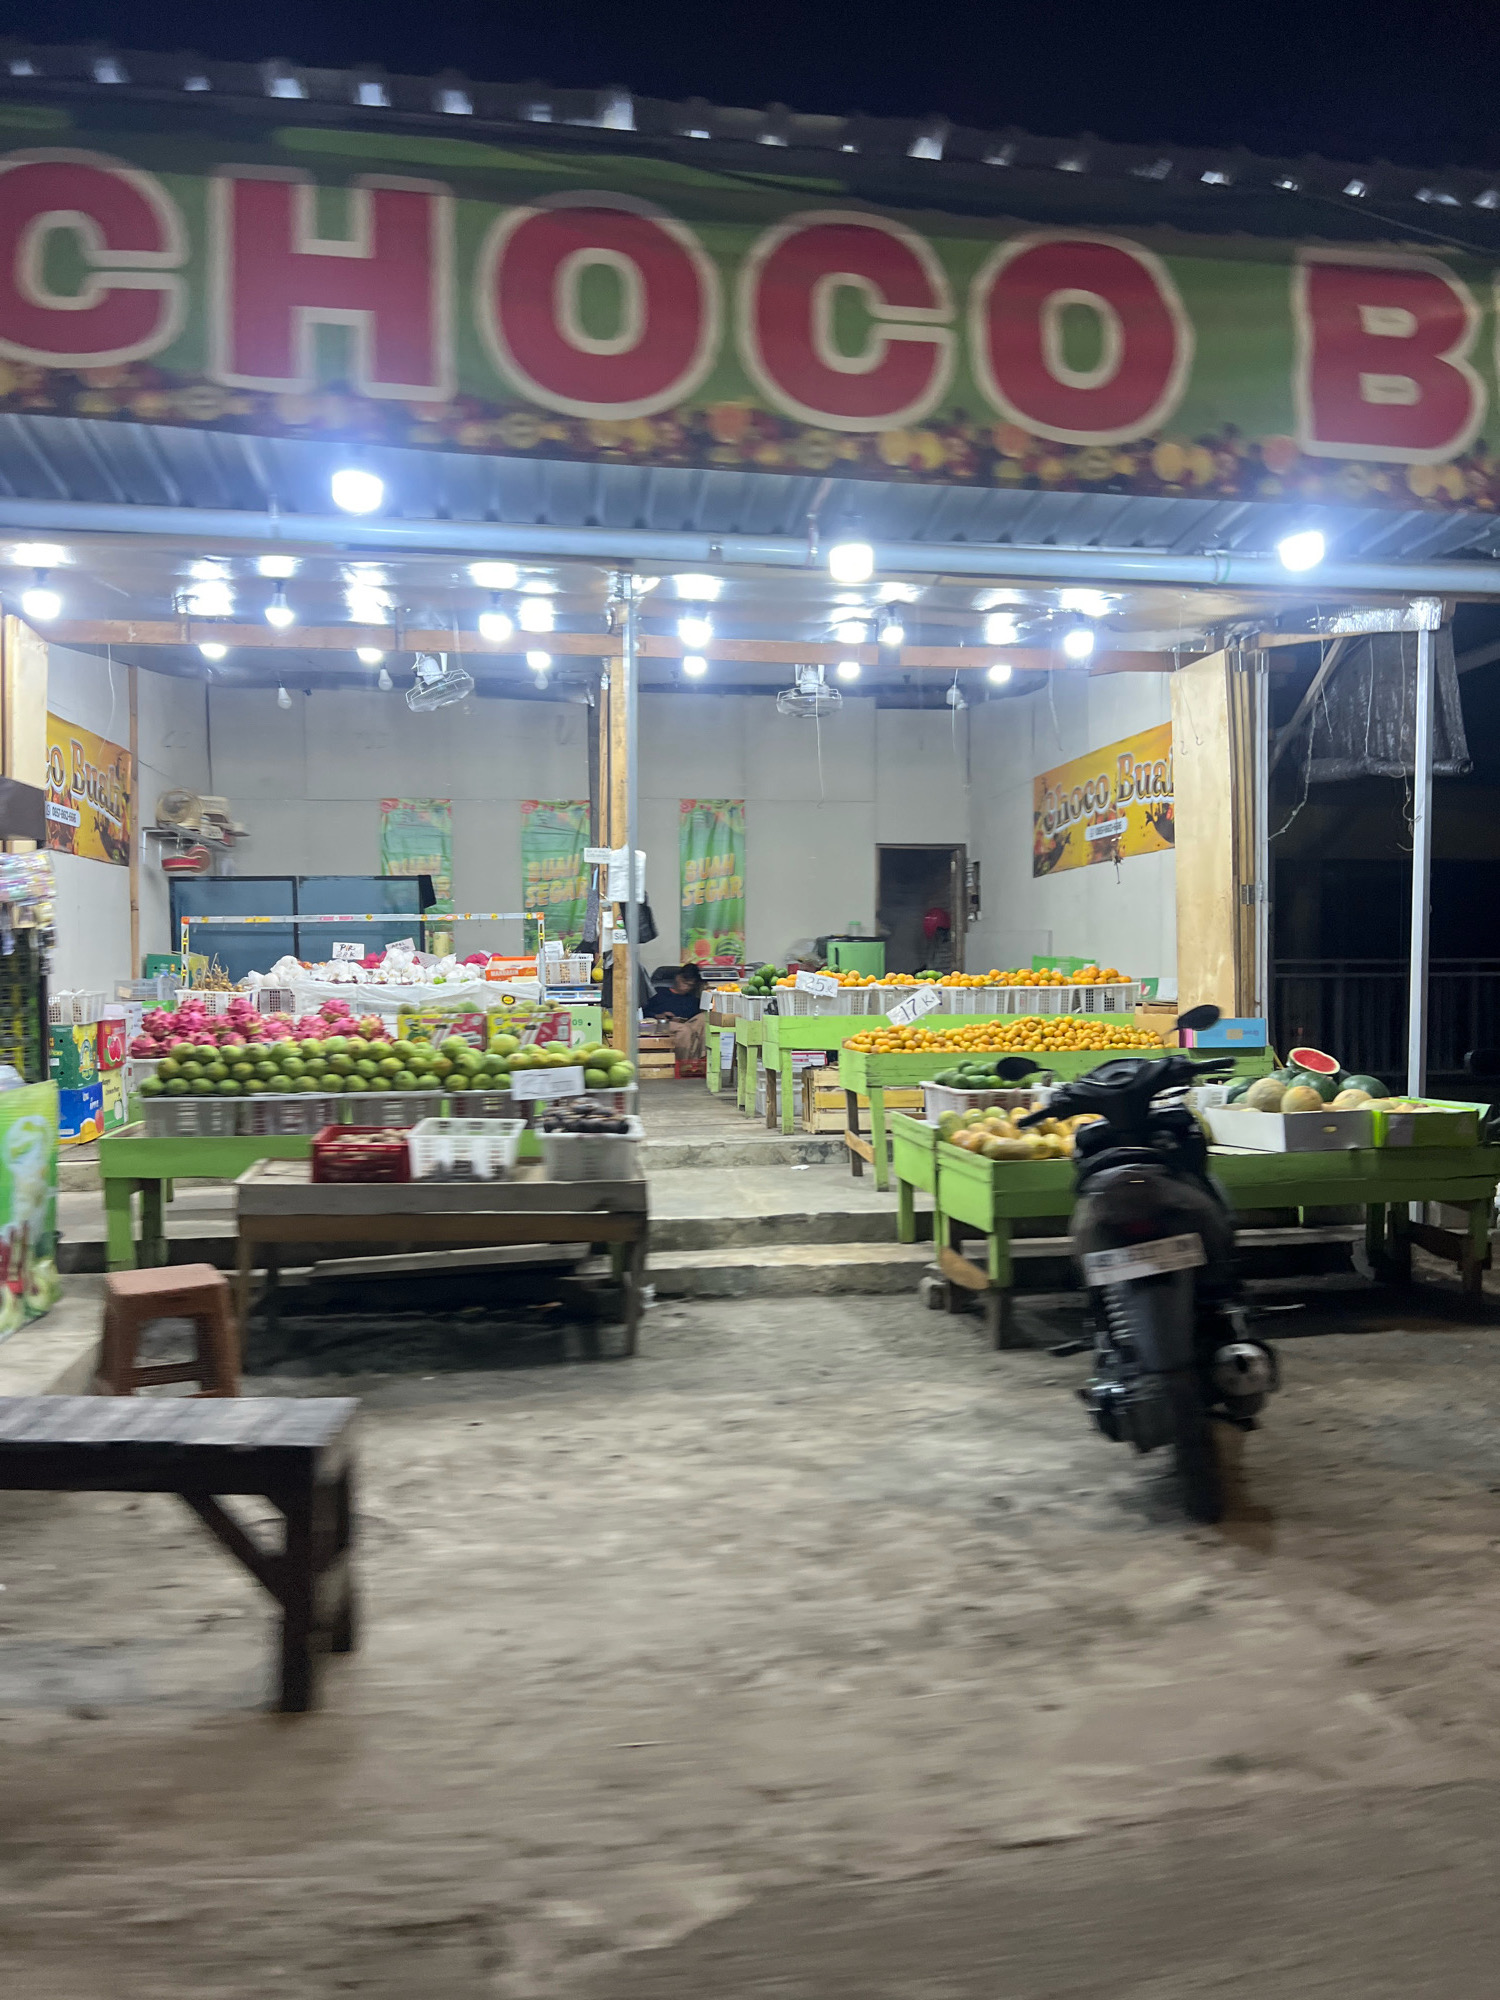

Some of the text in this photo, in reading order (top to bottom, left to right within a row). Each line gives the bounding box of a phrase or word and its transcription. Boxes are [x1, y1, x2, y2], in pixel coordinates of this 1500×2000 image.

[0, 146, 1500, 469] CHOCO B
[682, 876, 744, 907] SEGAR
